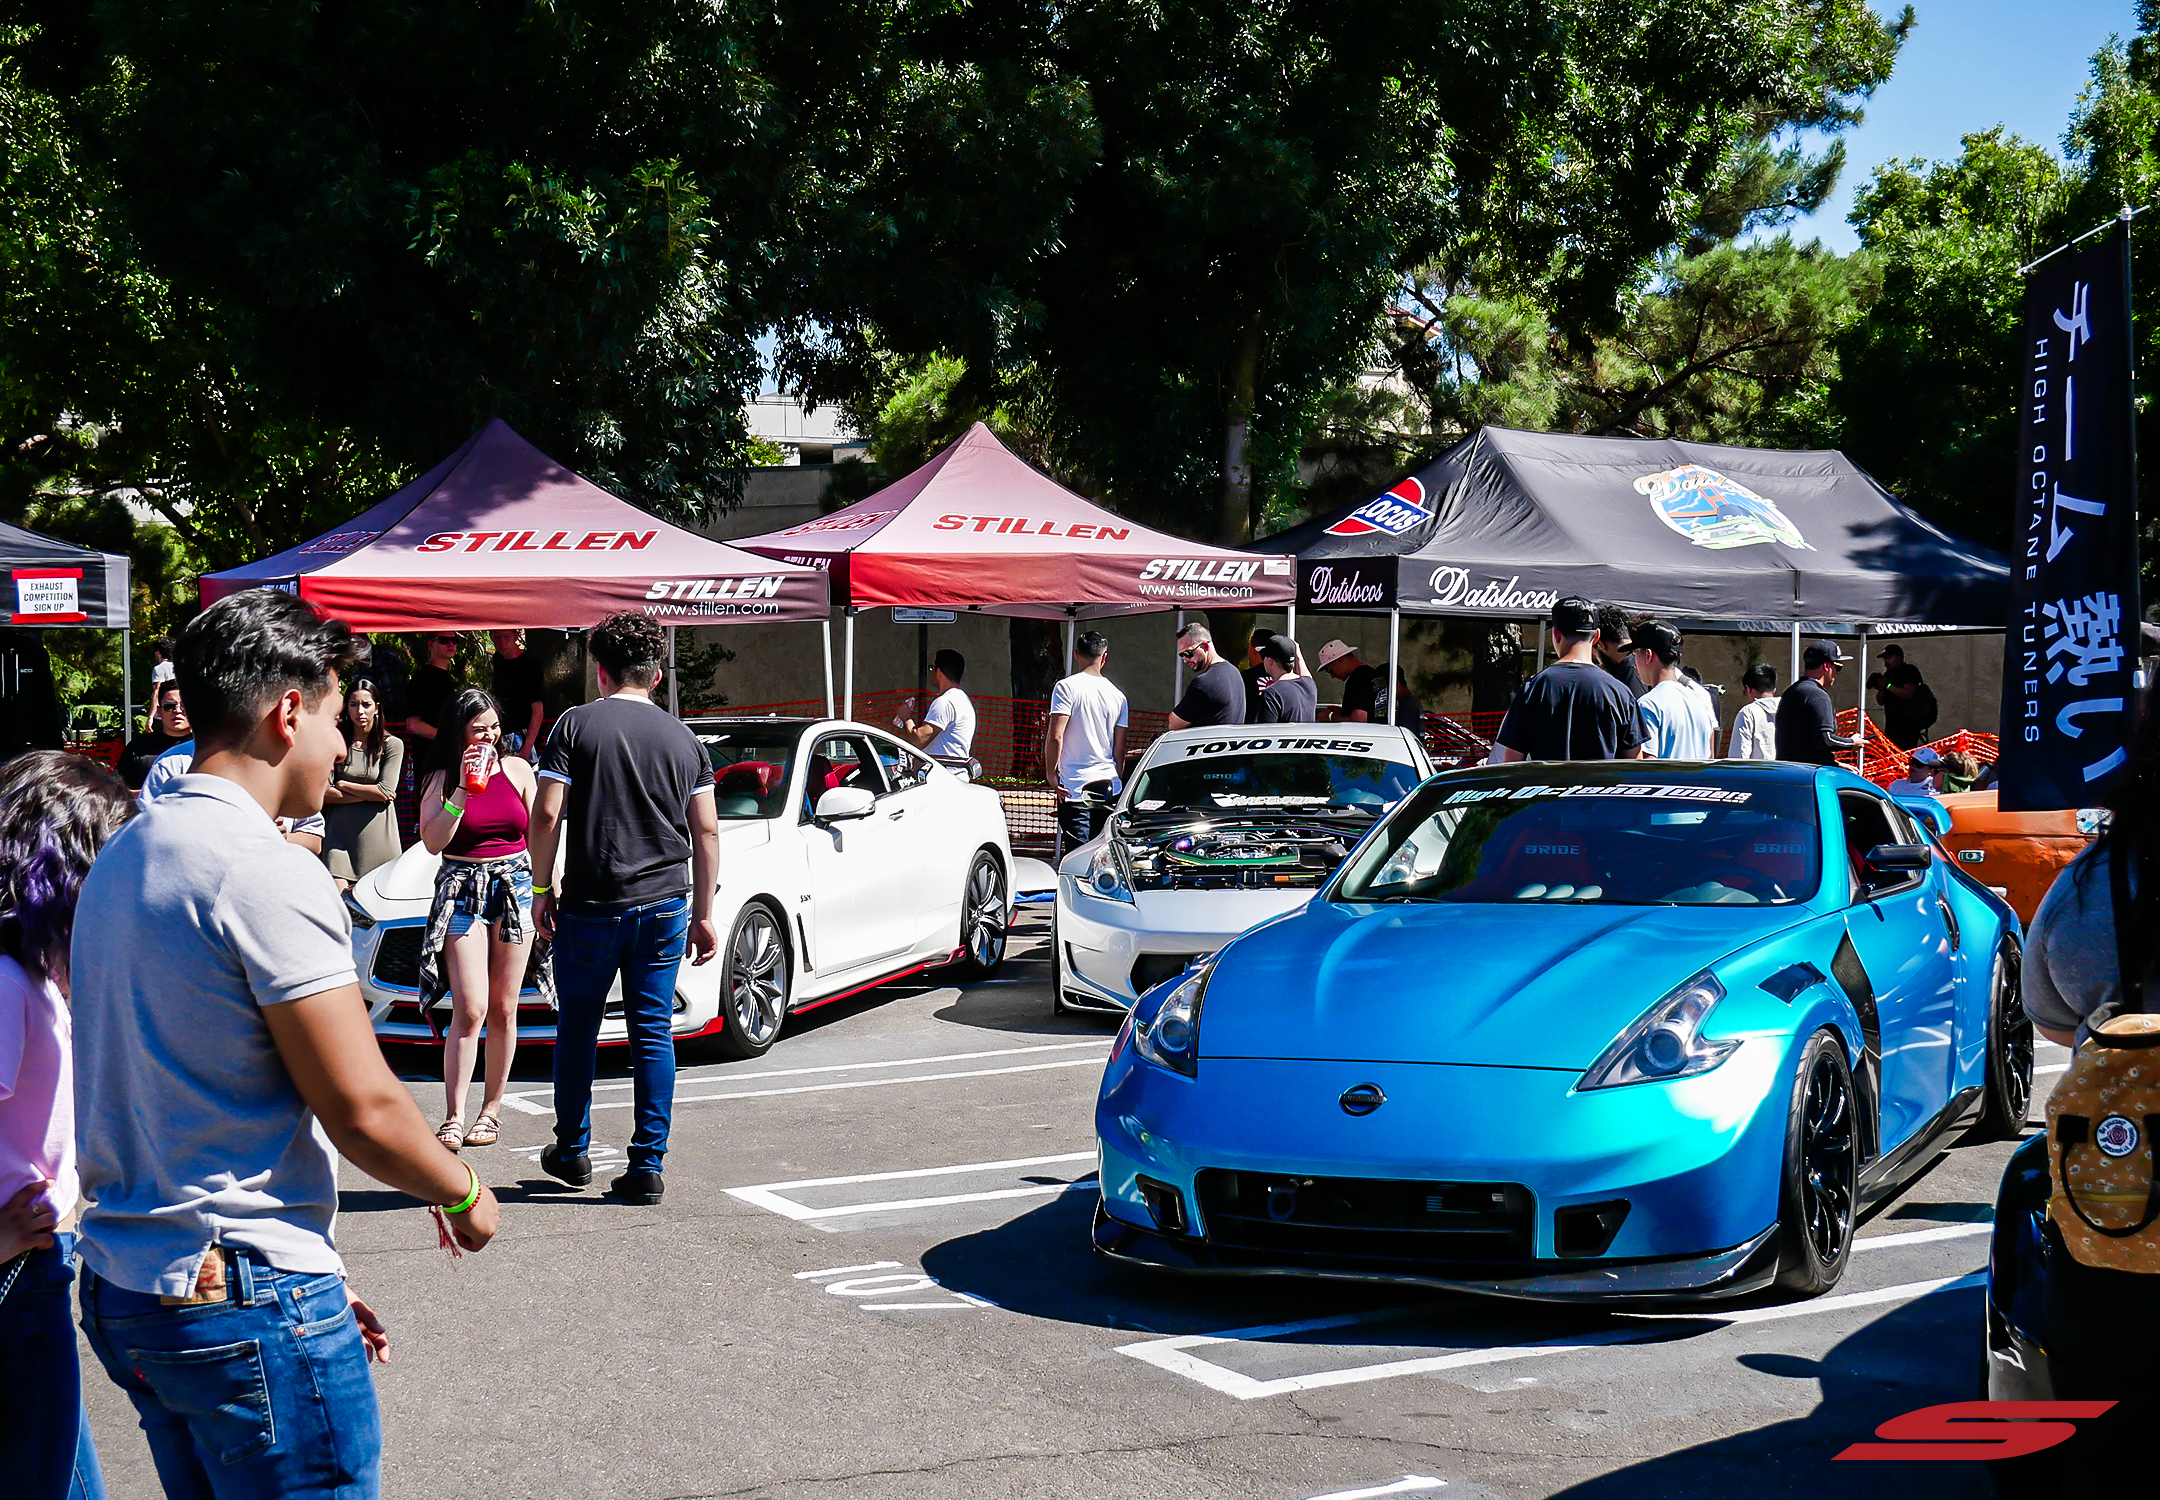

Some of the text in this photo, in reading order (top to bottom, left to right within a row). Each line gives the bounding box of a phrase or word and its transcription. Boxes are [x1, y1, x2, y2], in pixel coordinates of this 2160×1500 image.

[931, 512, 1134, 542] STILLEN
[414, 529, 663, 554] STILLEN
[2022, 338, 2049, 742] HIGH OCTANE TUNERS
[1139, 558, 1262, 583] STILLEN
[30, 582, 64, 591] EXHAUST
[645, 575, 787, 600] STILLEN
[1138, 583, 1254, 599] www.stillen.com
[1309, 566, 1384, 604] Datslocos
[1429, 565, 1560, 609] Datslocos
[23, 592, 74, 602] COMPETITION
[33, 603, 65, 612] SIGN UP
[642, 600, 780, 617] www.stillen.com
[1185, 738, 1375, 757] TOYO TIRES
[1443, 783, 1753, 804] High Octane Tuners
[1523, 844, 1580, 855] BRIDE
